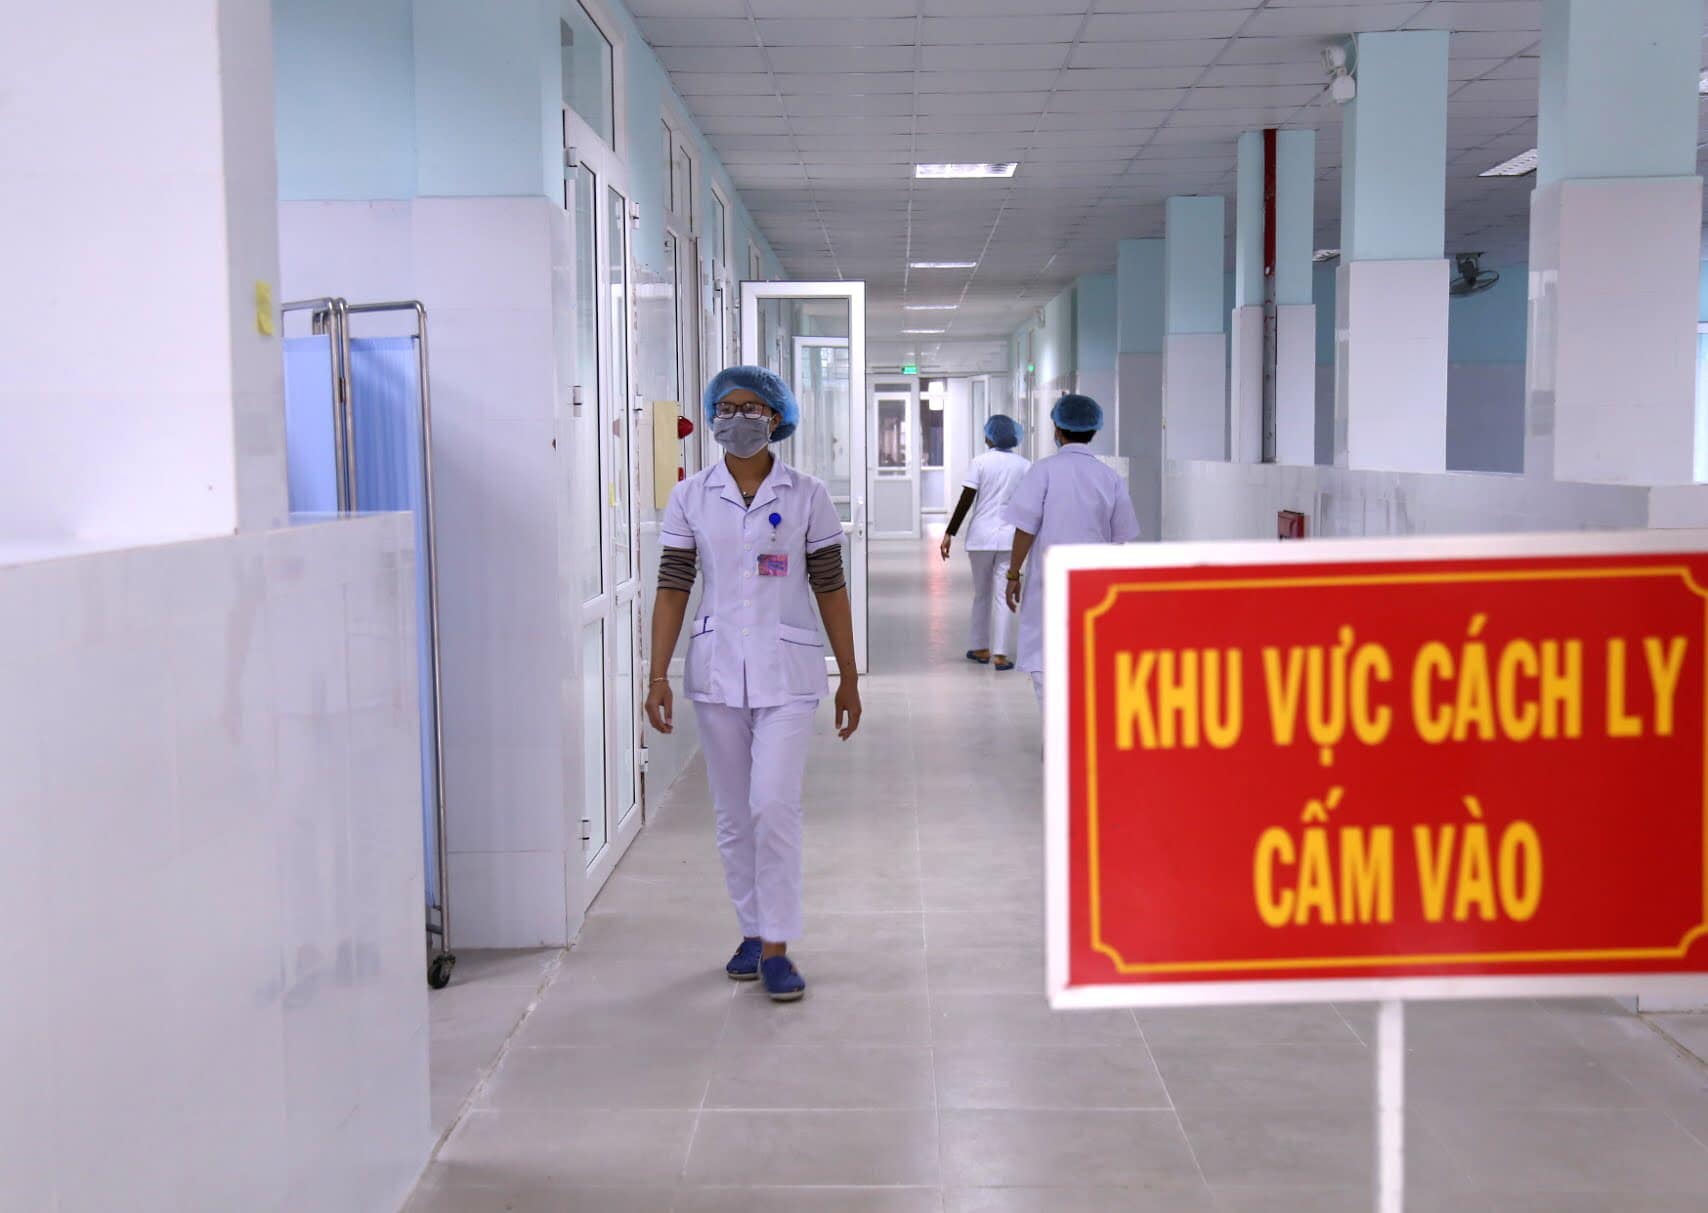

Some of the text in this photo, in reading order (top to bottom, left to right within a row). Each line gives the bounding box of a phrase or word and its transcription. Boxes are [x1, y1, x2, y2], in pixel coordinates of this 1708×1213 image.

[1115, 613, 1688, 766] KHU VỰC CÁCH LY
[1254, 786, 1542, 928] CẤM VÀO
